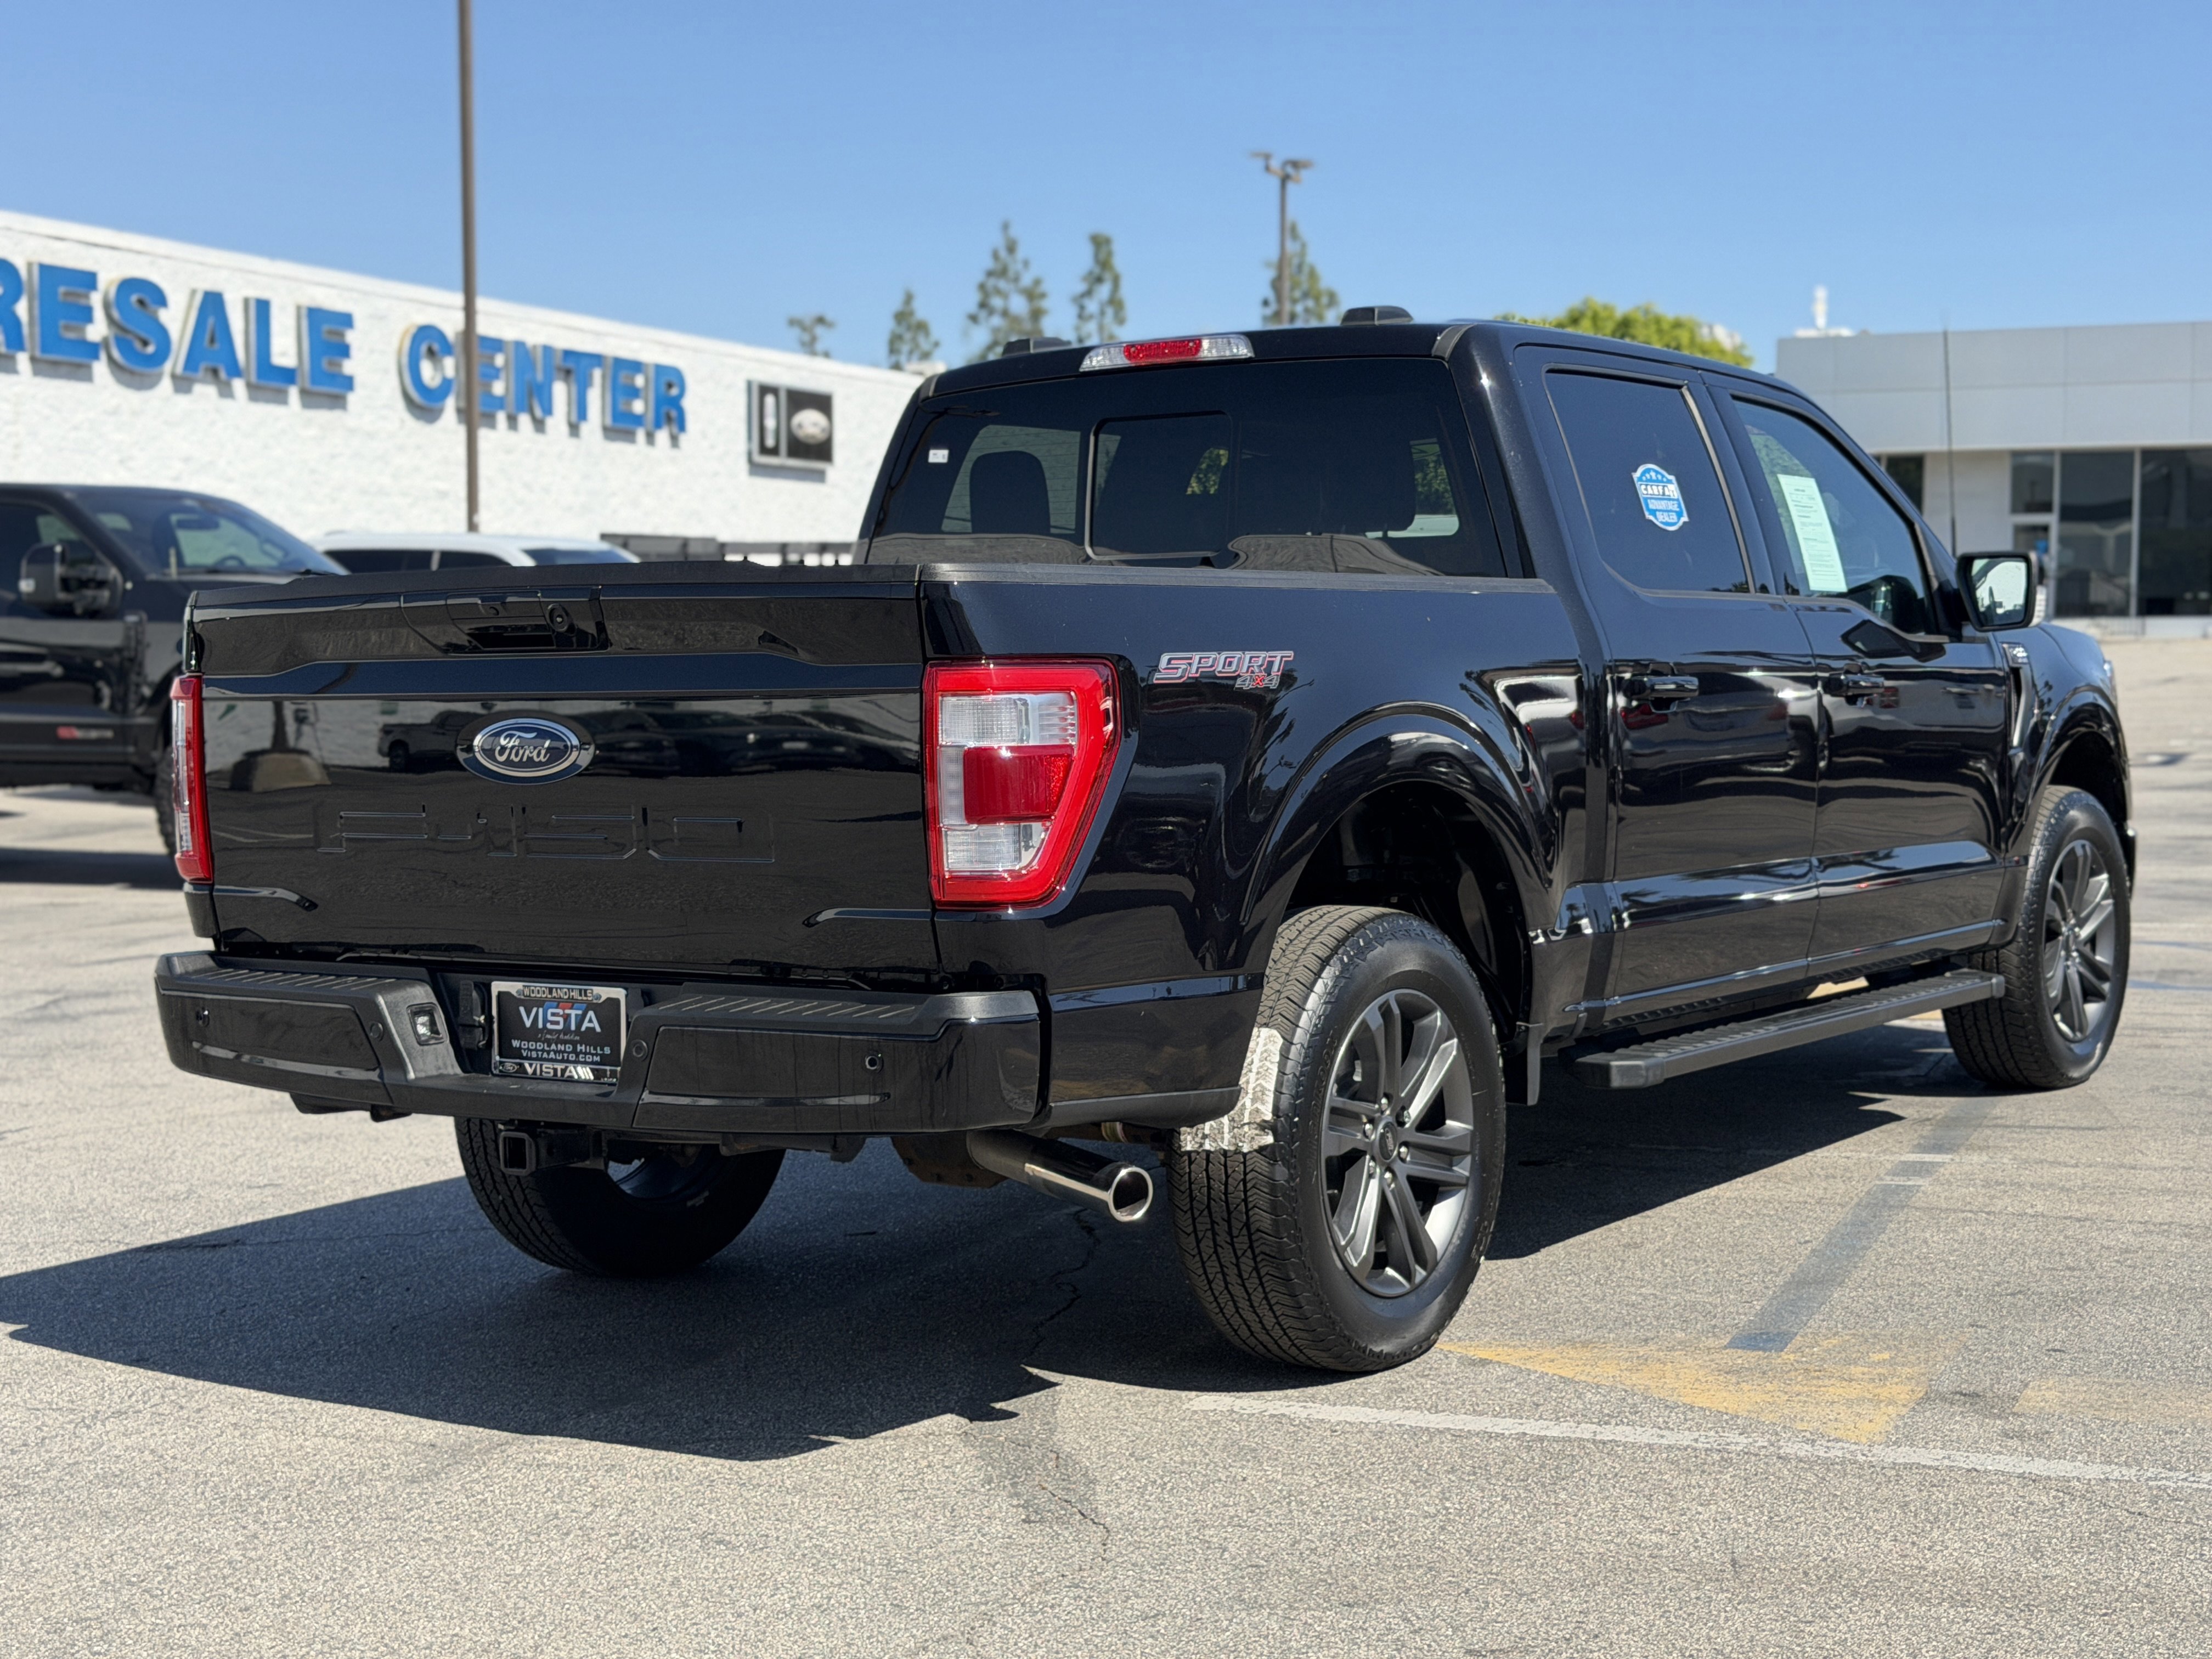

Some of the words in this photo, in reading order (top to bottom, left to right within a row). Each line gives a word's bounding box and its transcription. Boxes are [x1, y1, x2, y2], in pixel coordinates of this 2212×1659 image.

[399, 324, 686, 433] CENTER
[1641, 484, 1678, 499] CARFAX
[1153, 651, 1294, 683] SPORT
[495, 730, 550, 762] Ford
[523, 986, 568, 999] WOODLAND
[569, 989, 592, 1000] HILLS
[519, 1006, 601, 1032] VISTA
[524, 1062, 578, 1079] VISTA
